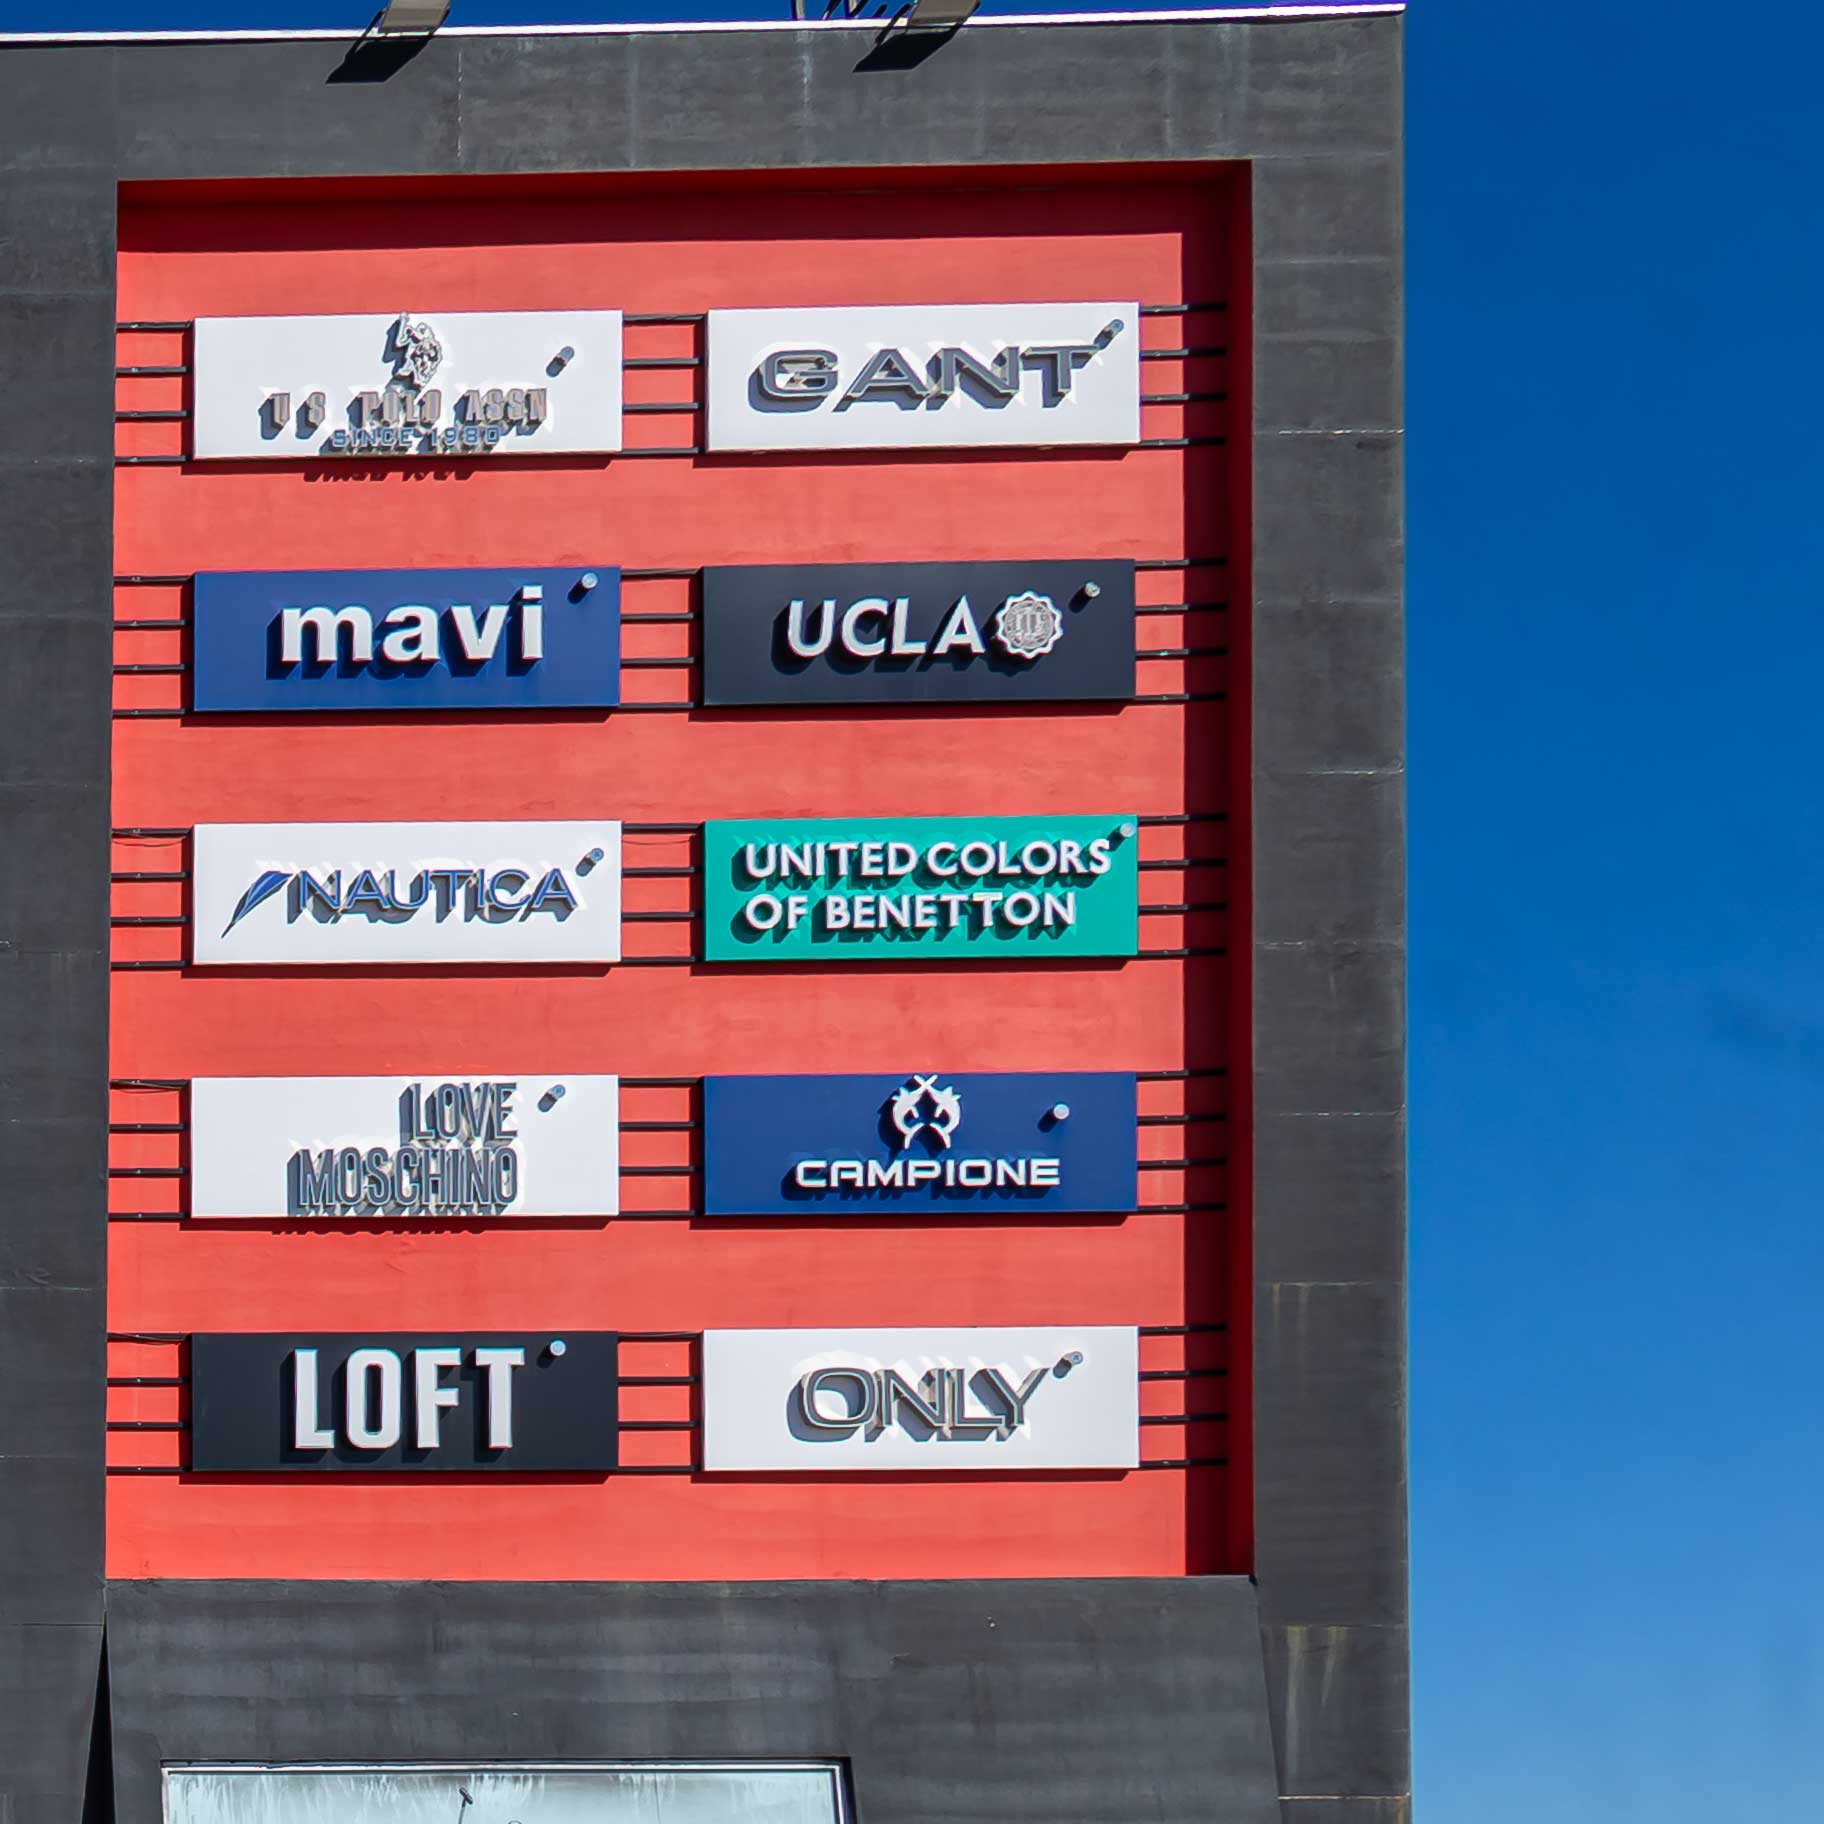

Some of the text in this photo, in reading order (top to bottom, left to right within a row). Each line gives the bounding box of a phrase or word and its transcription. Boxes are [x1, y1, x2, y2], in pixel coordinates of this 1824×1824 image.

[759, 344, 1103, 402] GANT
[360, 390, 442, 424] POLO
[465, 388, 547, 422] ASSN
[331, 427, 414, 448] SINCE
[281, 585, 544, 664] mavi
[787, 595, 985, 658] UCLA
[745, 838, 1112, 881] UNITED COLORS
[298, 868, 579, 914] NAUTICA
[745, 891, 1077, 931] OF BENETTON
[410, 1082, 519, 1142] LOVE
[298, 1148, 520, 1207] MOSCHINO
[795, 1159, 1061, 1188] CAMPIONE
[293, 1347, 525, 1450] LOFT
[801, 1367, 1051, 1430] ONLY
